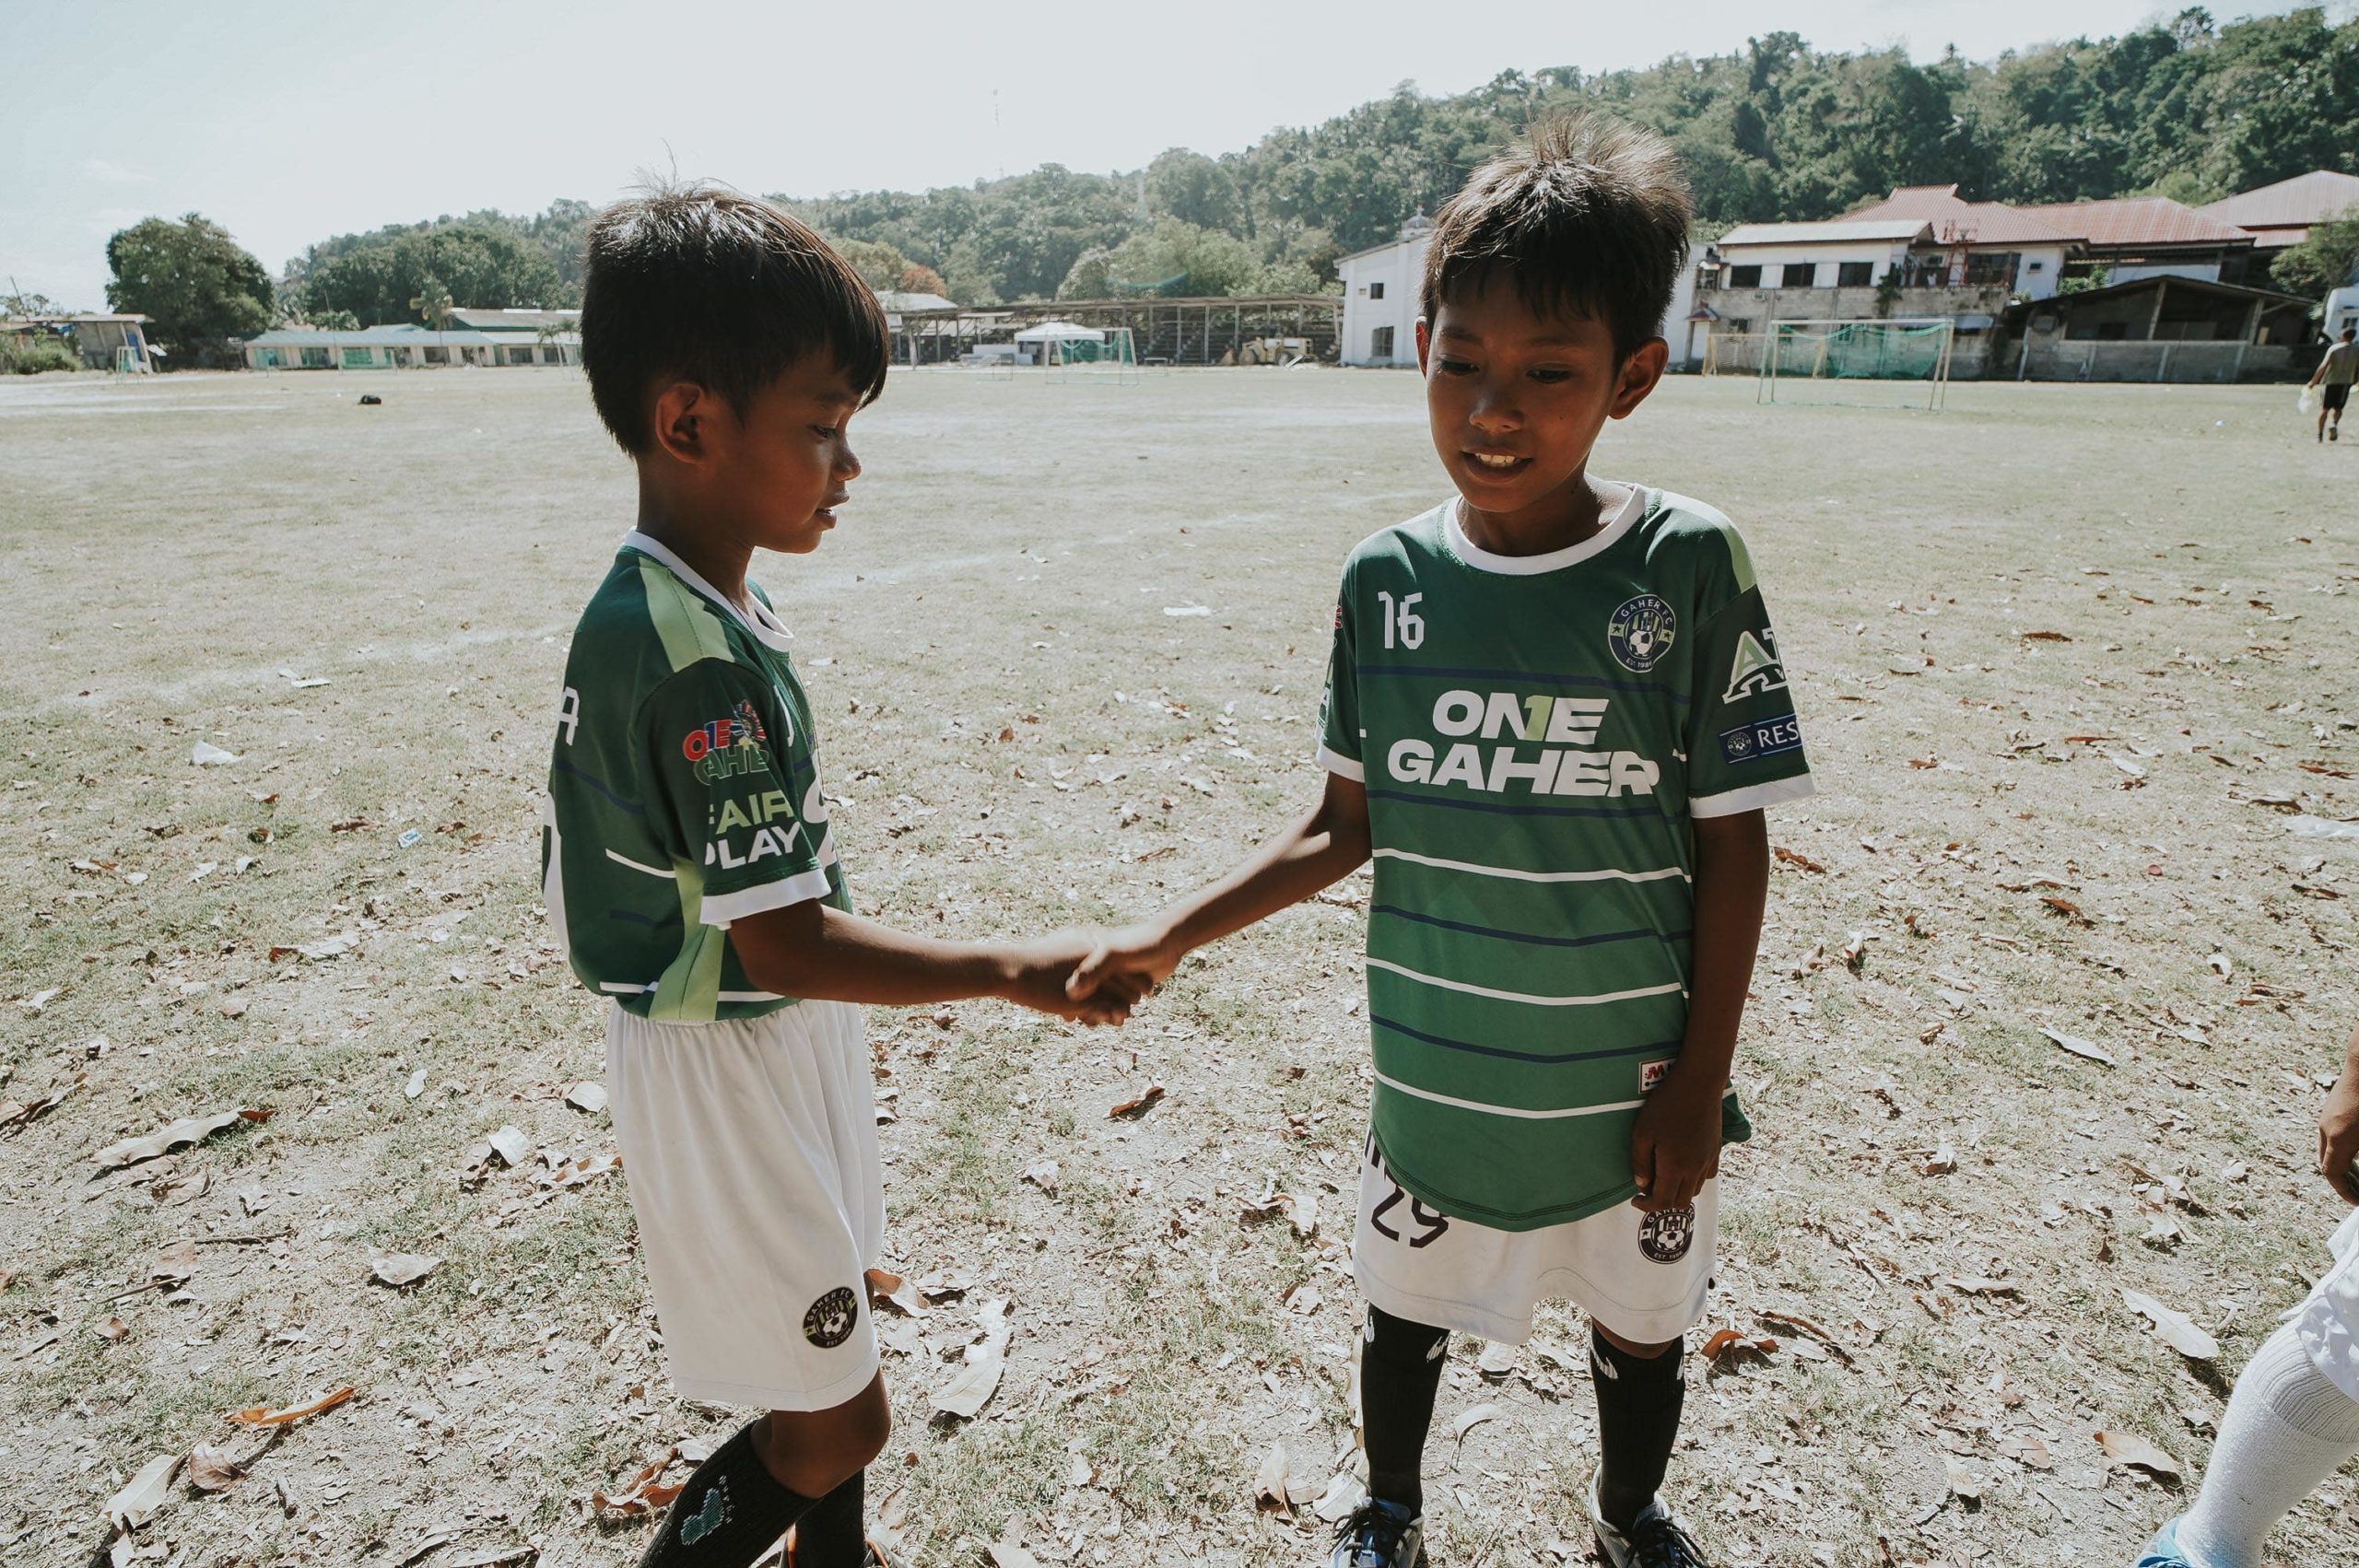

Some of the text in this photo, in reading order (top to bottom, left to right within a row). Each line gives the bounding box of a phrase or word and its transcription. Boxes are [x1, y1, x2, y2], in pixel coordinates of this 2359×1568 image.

[1379, 591, 1425, 649] 16
[1620, 599, 1673, 626] GAHER FC
[1387, 738, 1661, 798] GAHER
[709, 789, 795, 836] AIR
